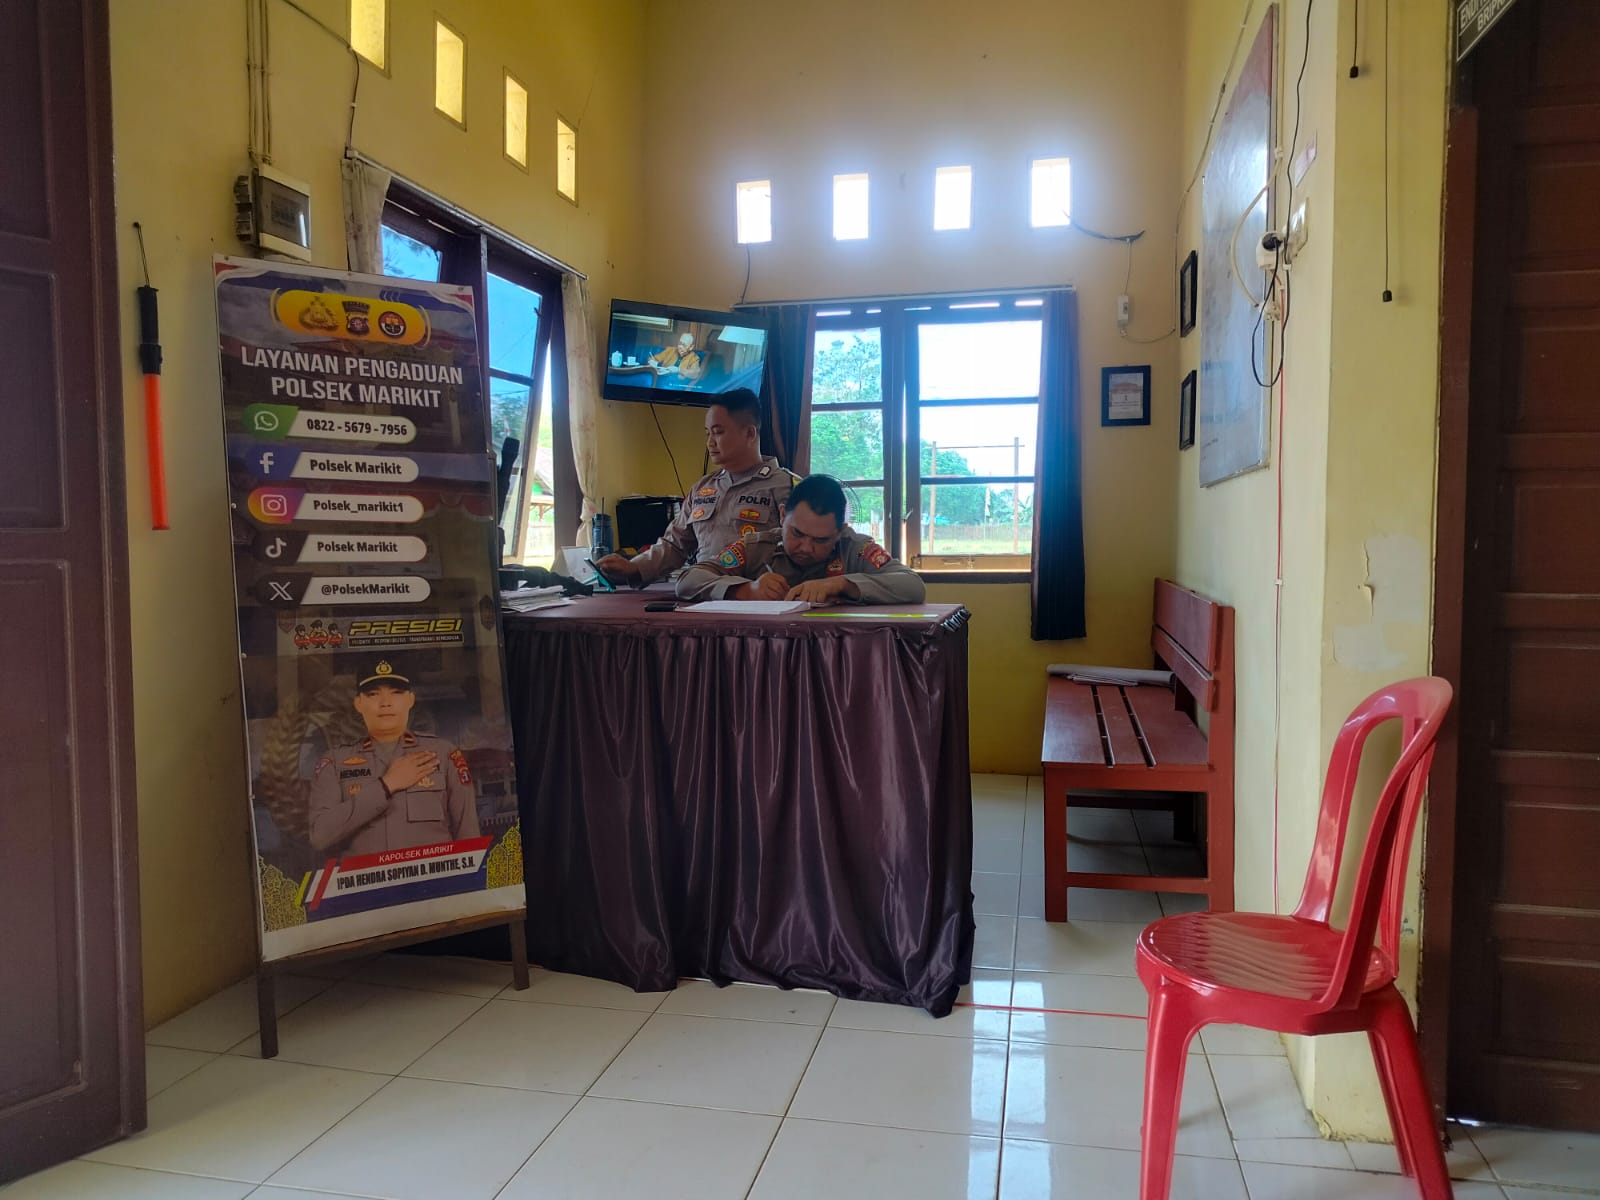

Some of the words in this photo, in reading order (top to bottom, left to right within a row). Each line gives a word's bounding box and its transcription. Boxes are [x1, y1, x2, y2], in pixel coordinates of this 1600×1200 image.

[241, 346, 339, 374] LAYANAN
[346, 357, 463, 384] PENGADUAN
[271, 376, 353, 402] POLSEK
[358, 384, 441, 408] MARIKIT
[307, 418, 334, 432] 0822
[344, 421, 371, 434] 5679
[381, 423, 408, 436] 7956
[310, 459, 352, 473] Polsek
[355, 461, 402, 475] Marikit
[313, 499, 404, 514] Polsek_marikit1
[739, 495, 771, 506] POLRI
[317, 541, 354, 552] Polsek
[357, 541, 398, 553] Marikit
[321, 583, 410, 596] @PolsekMarikit
[348, 618, 463, 636] PRESISI
[379, 850, 421, 863] KAPOLSEK
[422, 844, 454, 857] MARIKIT
[336, 876, 356, 891] IPDA
[356, 872, 387, 887] HENDRA
[388, 867, 419, 883] SOPIYAN
[420, 865, 428, 877] D.
[462, 856, 475, 870] S.H.
